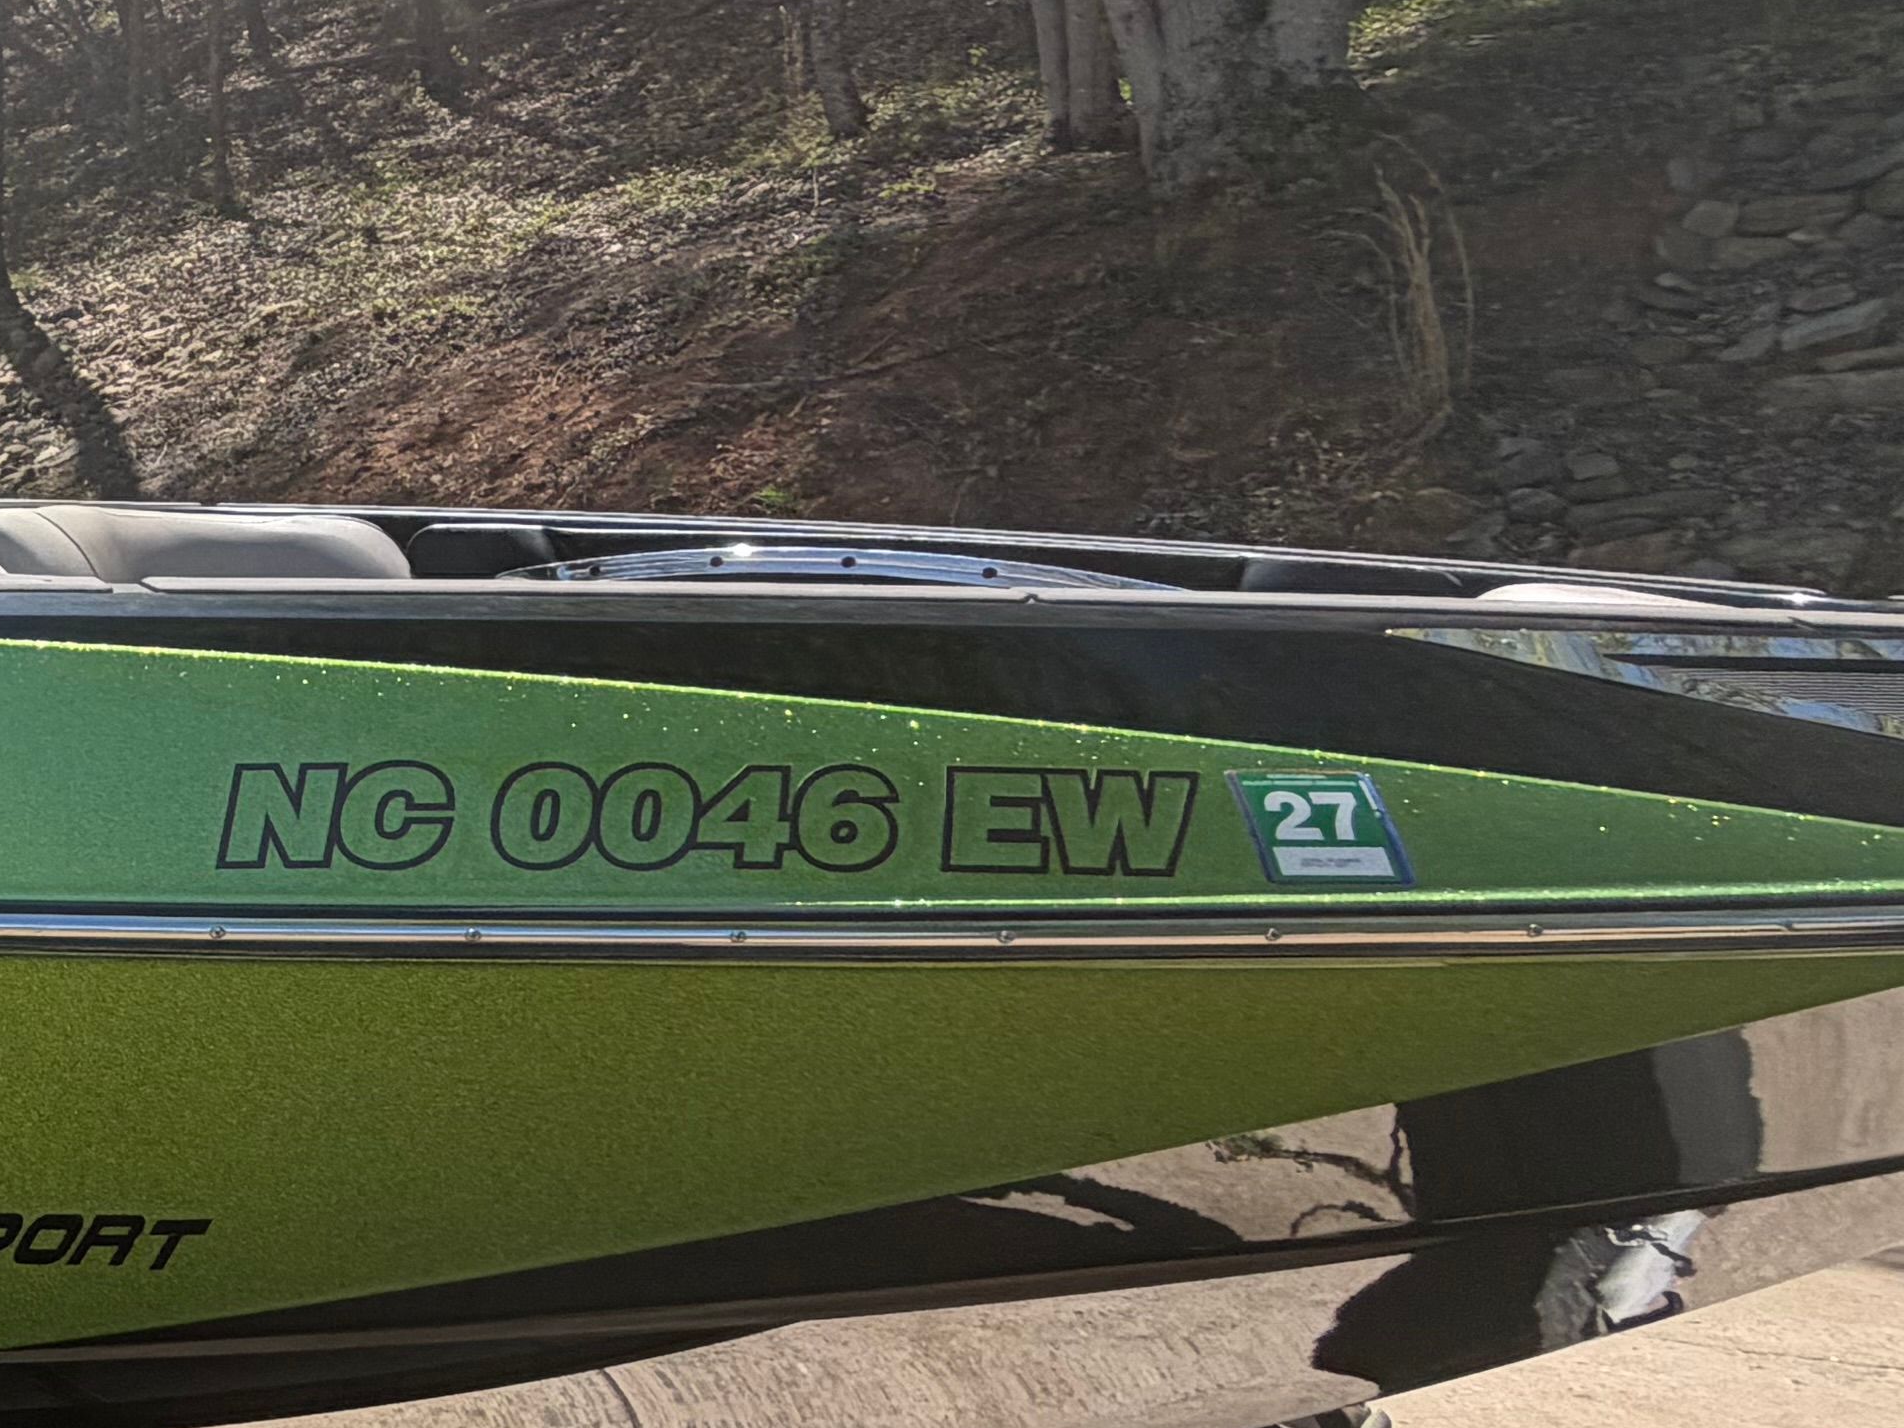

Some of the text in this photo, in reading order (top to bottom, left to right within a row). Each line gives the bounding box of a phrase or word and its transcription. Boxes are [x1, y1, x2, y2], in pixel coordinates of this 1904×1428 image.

[215, 759, 1198, 878] NC 0046 EW
[1263, 790, 1358, 841] 27
